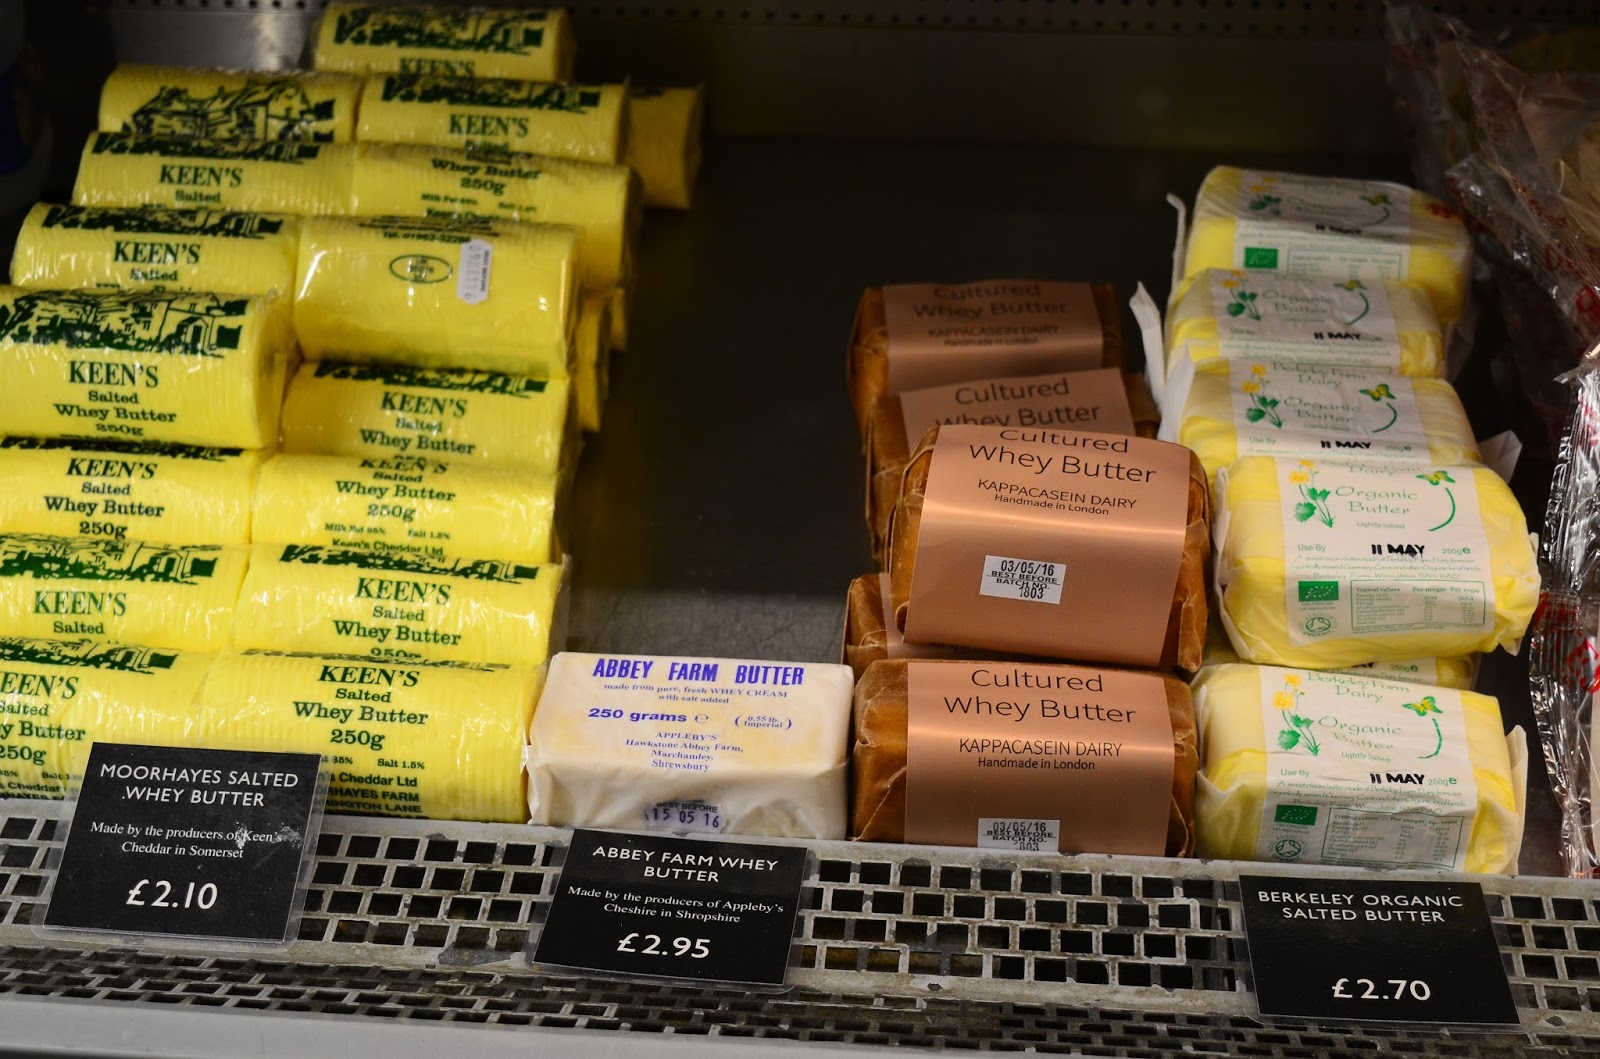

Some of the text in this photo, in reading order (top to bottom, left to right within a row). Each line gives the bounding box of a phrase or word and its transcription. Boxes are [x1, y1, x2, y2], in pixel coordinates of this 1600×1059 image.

[449, 114, 529, 137] KEEN'S
[159, 165, 243, 187] KEEN'S
[432, 158, 480, 175] Whey
[485, 166, 541, 179] Butter
[461, 178, 506, 196] 250g
[175, 190, 221, 203] Salted
[113, 240, 200, 264] KEEN'S
[130, 268, 178, 282] Salted
[933, 284, 1041, 301] Cultured
[912, 302, 1067, 320] Whey Butter
[1328, 332, 1360, 340] MAY
[69, 361, 158, 388] KEEN'S
[88, 390, 139, 404] Salted
[955, 378, 1069, 405] Cultured
[53, 404, 176, 423] Whey Butter
[380, 392, 468, 418] KEEN'S
[1018, 405, 1101, 427] Butter
[96, 423, 143, 436] 250g
[395, 418, 443, 432] Salted
[359, 429, 476, 455] Whey Butter
[1000, 429, 1129, 453] Cultured
[66, 458, 158, 480] KEEN'S
[359, 458, 449, 474] KEEN'S
[969, 444, 1157, 483] Whey Butter
[373, 471, 422, 483] Salted
[81, 482, 131, 495] Salted
[335, 480, 456, 501] Whey Butter
[978, 478, 1137, 509] KAPPACASEIN DAIRY
[1335, 486, 1418, 500] Organic
[44, 496, 165, 517] Whey Butter
[367, 504, 415, 522] 250g
[994, 493, 1109, 516] Handmade in London
[1347, 501, 1411, 514] Butter
[79, 522, 128, 539] 250g
[1316, 544, 1326, 552] By
[1387, 544, 1425, 556] MAY
[1001, 560, 1055, 576] 03/05/16
[996, 578, 1029, 588] BATCH
[1019, 574, 1057, 583] BEFORE
[355, 577, 452, 605] KEEN'S
[1019, 587, 1044, 599] 1803
[33, 591, 127, 617] KEEN'S
[372, 605, 425, 622] Salted
[53, 622, 105, 634] Salted
[333, 620, 461, 646] Whey Butter
[318, 665, 419, 687] KEEN'S
[592, 658, 804, 685] ABBEY FARM BUTTER
[0, 671, 79, 699] EEN'S
[971, 669, 1103, 692] Cultured
[1306, 672, 1369, 689] Berkeley
[335, 688, 392, 703] Salted
[604, 683, 630, 691] made
[631, 684, 654, 692] from
[683, 686, 708, 694] fresh
[710, 688, 744, 696] WHEY
[746, 689, 787, 698] CREAM
[658, 693, 729, 704] with salt added
[1335, 685, 1383, 702] Dairy
[0, 700, 49, 716] Salted
[293, 701, 428, 725] Whey Butter
[588, 708, 687, 723] 250 grams
[943, 696, 1136, 723] Whey Butter
[18, 721, 86, 740] Butter
[743, 720, 783, 729] Imperial
[1318, 715, 1402, 735] Organic
[330, 729, 385, 750] 250g
[655, 731, 717, 742] APPLEBY'S
[1333, 732, 1394, 749] Butter
[625, 739, 679, 750] Hawkstone
[681, 742, 712, 752] Abbey
[959, 738, 1122, 757] KAPPACASEIN DAIRY
[378, 758, 398, 767] Salt
[978, 757, 1095, 770] Handmade in London
[1341, 751, 1390, 762] Lightly Salted
[651, 759, 710, 772] Shrewsbury
[1299, 770, 1310, 778] By
[100, 764, 221, 785] MOORHAYES
[228, 771, 299, 788] SALTED
[339, 772, 418, 787] Cheddar Ltd
[1386, 773, 1425, 785] MAY
[190, 791, 265, 807] BUTTER
[382, 791, 420, 802] FARM
[385, 804, 422, 813] LANE
[682, 803, 718, 813] BEFORE
[653, 808, 719, 828] 15 05 16
[993, 821, 1046, 832] 03/05/16
[91, 821, 283, 843] Made by the producers of Keen's
[121, 841, 244, 858] Cheddar in Somerset
[592, 846, 779, 871] ABBEY FARM WHEY
[643, 866, 719, 883] BUTTER
[126, 879, 218, 910] £2.10
[567, 886, 784, 914] Made by the producers of Appleby's
[1258, 891, 1463, 907] BERKELEY ORGANIC
[604, 903, 741, 924] Cheshire in Shropshire
[1282, 907, 1445, 923] SALTED BUTTER
[616, 932, 711, 959] £2.95
[1332, 978, 1431, 1001] £2.70
